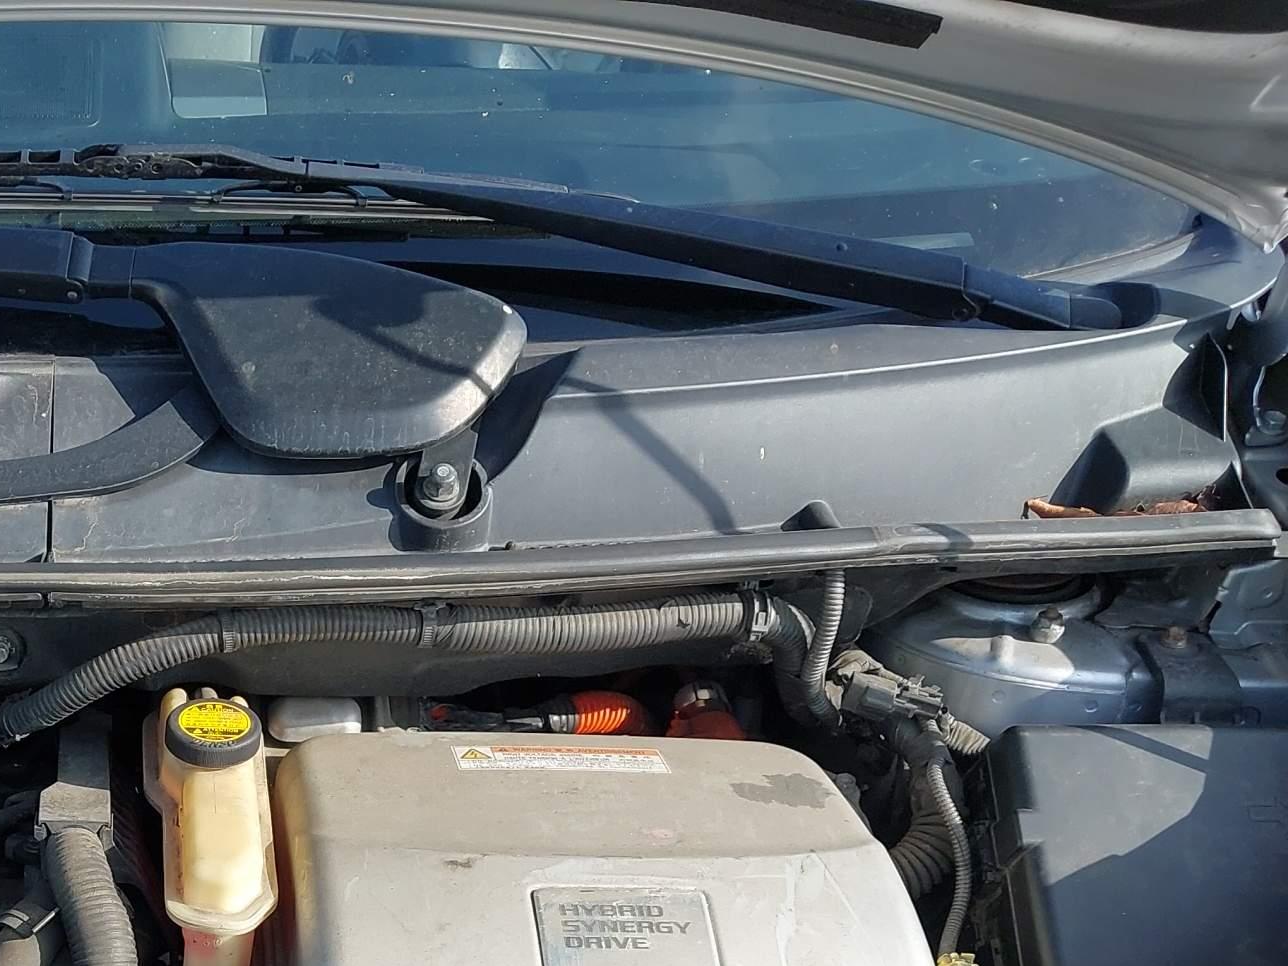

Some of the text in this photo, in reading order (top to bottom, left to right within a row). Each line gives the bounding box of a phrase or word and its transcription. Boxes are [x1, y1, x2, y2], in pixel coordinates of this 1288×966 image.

[558, 903, 664, 918] HYBRID
[562, 919, 692, 935] SYNERGY
[563, 936, 650, 950] DRIVE
